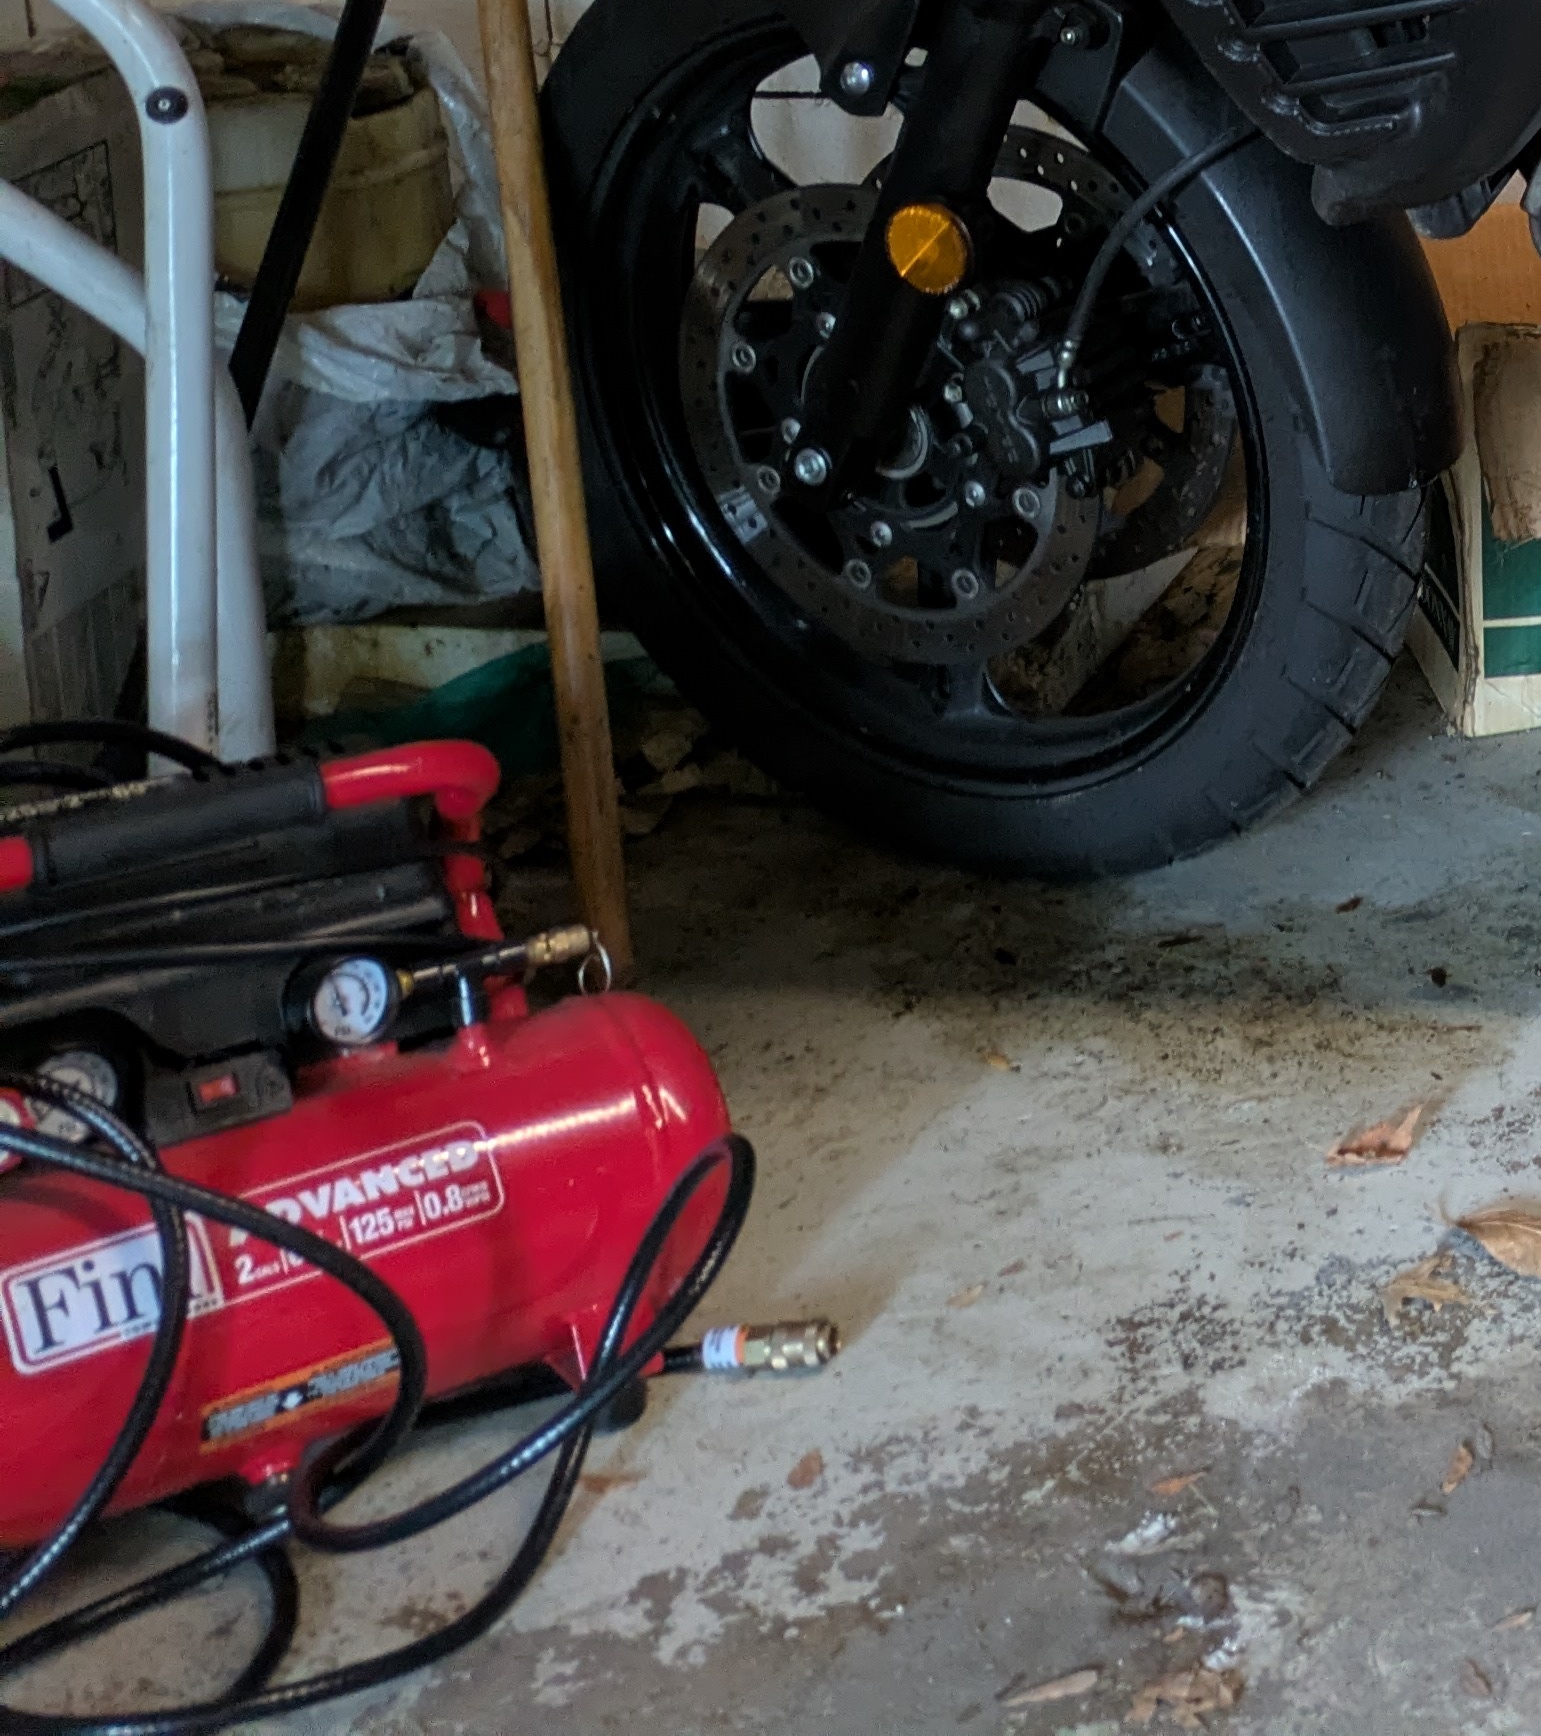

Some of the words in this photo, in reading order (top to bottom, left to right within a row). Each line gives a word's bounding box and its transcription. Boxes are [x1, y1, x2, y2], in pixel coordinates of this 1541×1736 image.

[350, 1208, 395, 1255] 125
[424, 1184, 464, 1221] 0.8
[17, 1256, 198, 1357] Fin
